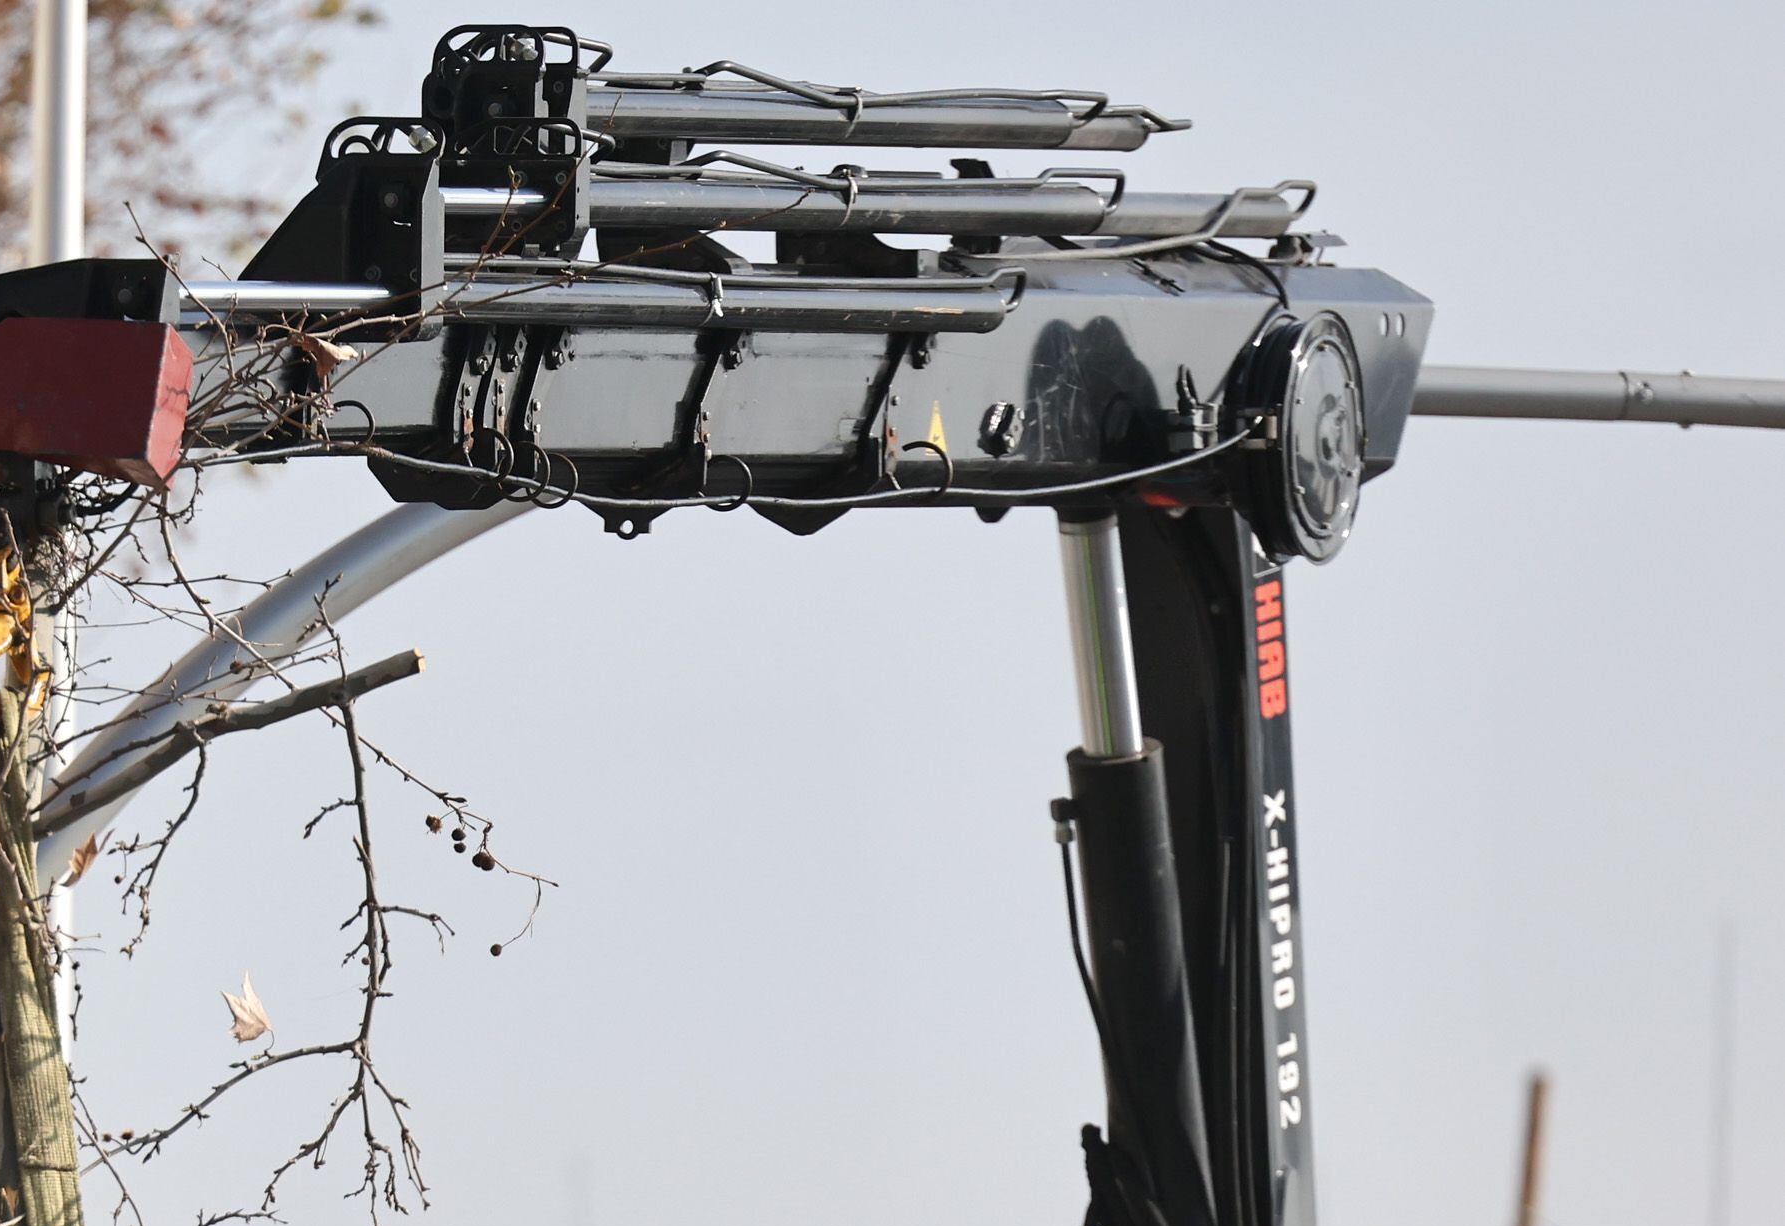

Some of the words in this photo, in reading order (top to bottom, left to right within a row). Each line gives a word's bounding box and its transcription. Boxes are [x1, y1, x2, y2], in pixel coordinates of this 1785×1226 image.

[1255, 580, 1286, 719] HIAB
[1263, 789, 1295, 1010] X-HIPRO
[1276, 1031, 1302, 1129] 192
